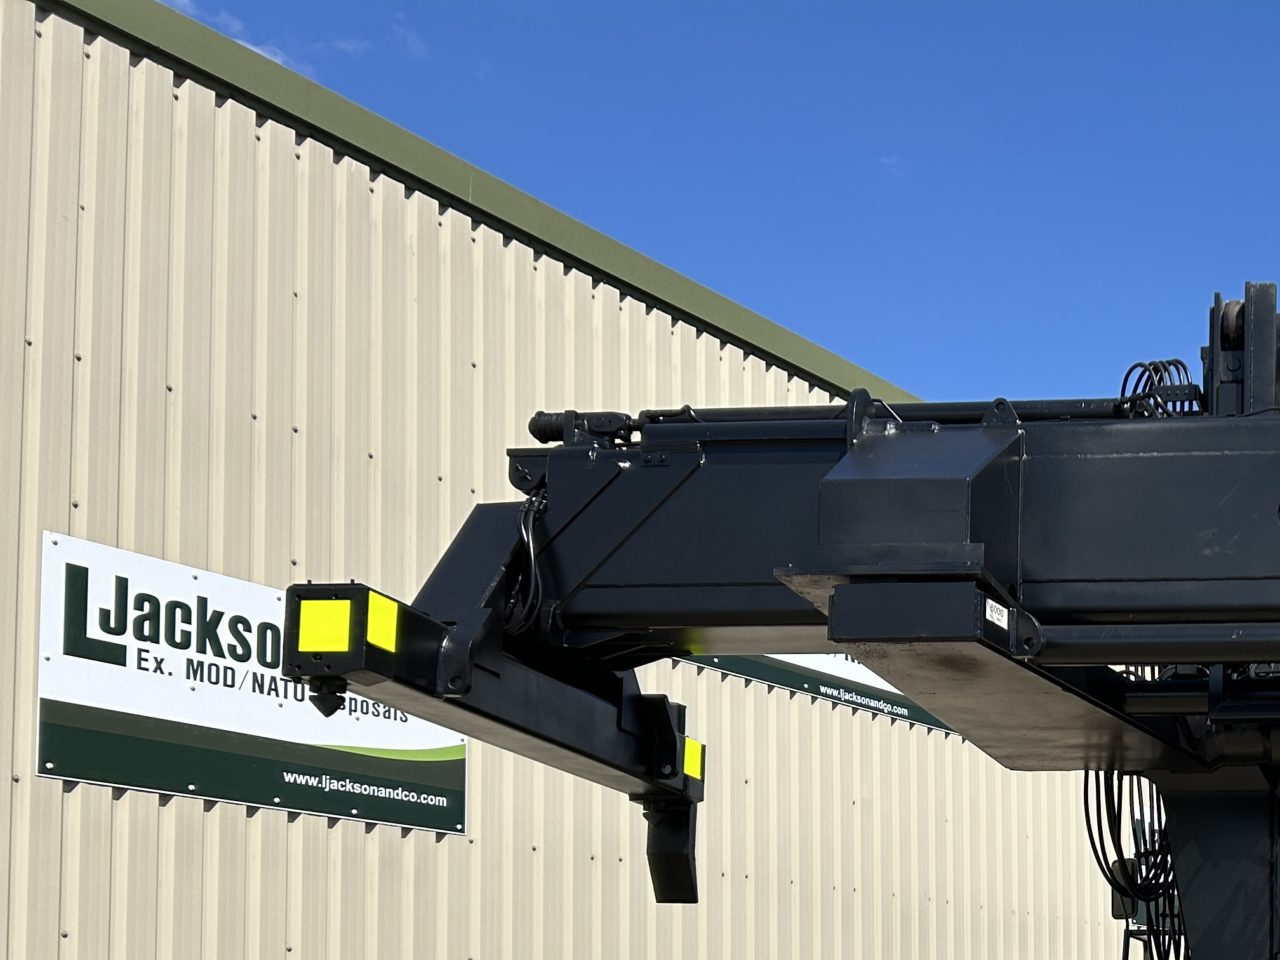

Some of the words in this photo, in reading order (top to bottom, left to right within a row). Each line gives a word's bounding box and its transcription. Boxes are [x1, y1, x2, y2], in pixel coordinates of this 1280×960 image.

[63, 562, 281, 669] LJackso
[137, 648, 173, 676] Ex.
[185, 658, 305, 702] MOD/NATO
[820, 685, 908, 716] www.ljacksonandco.com
[283, 771, 447, 807] www.ljacksonandco.com
